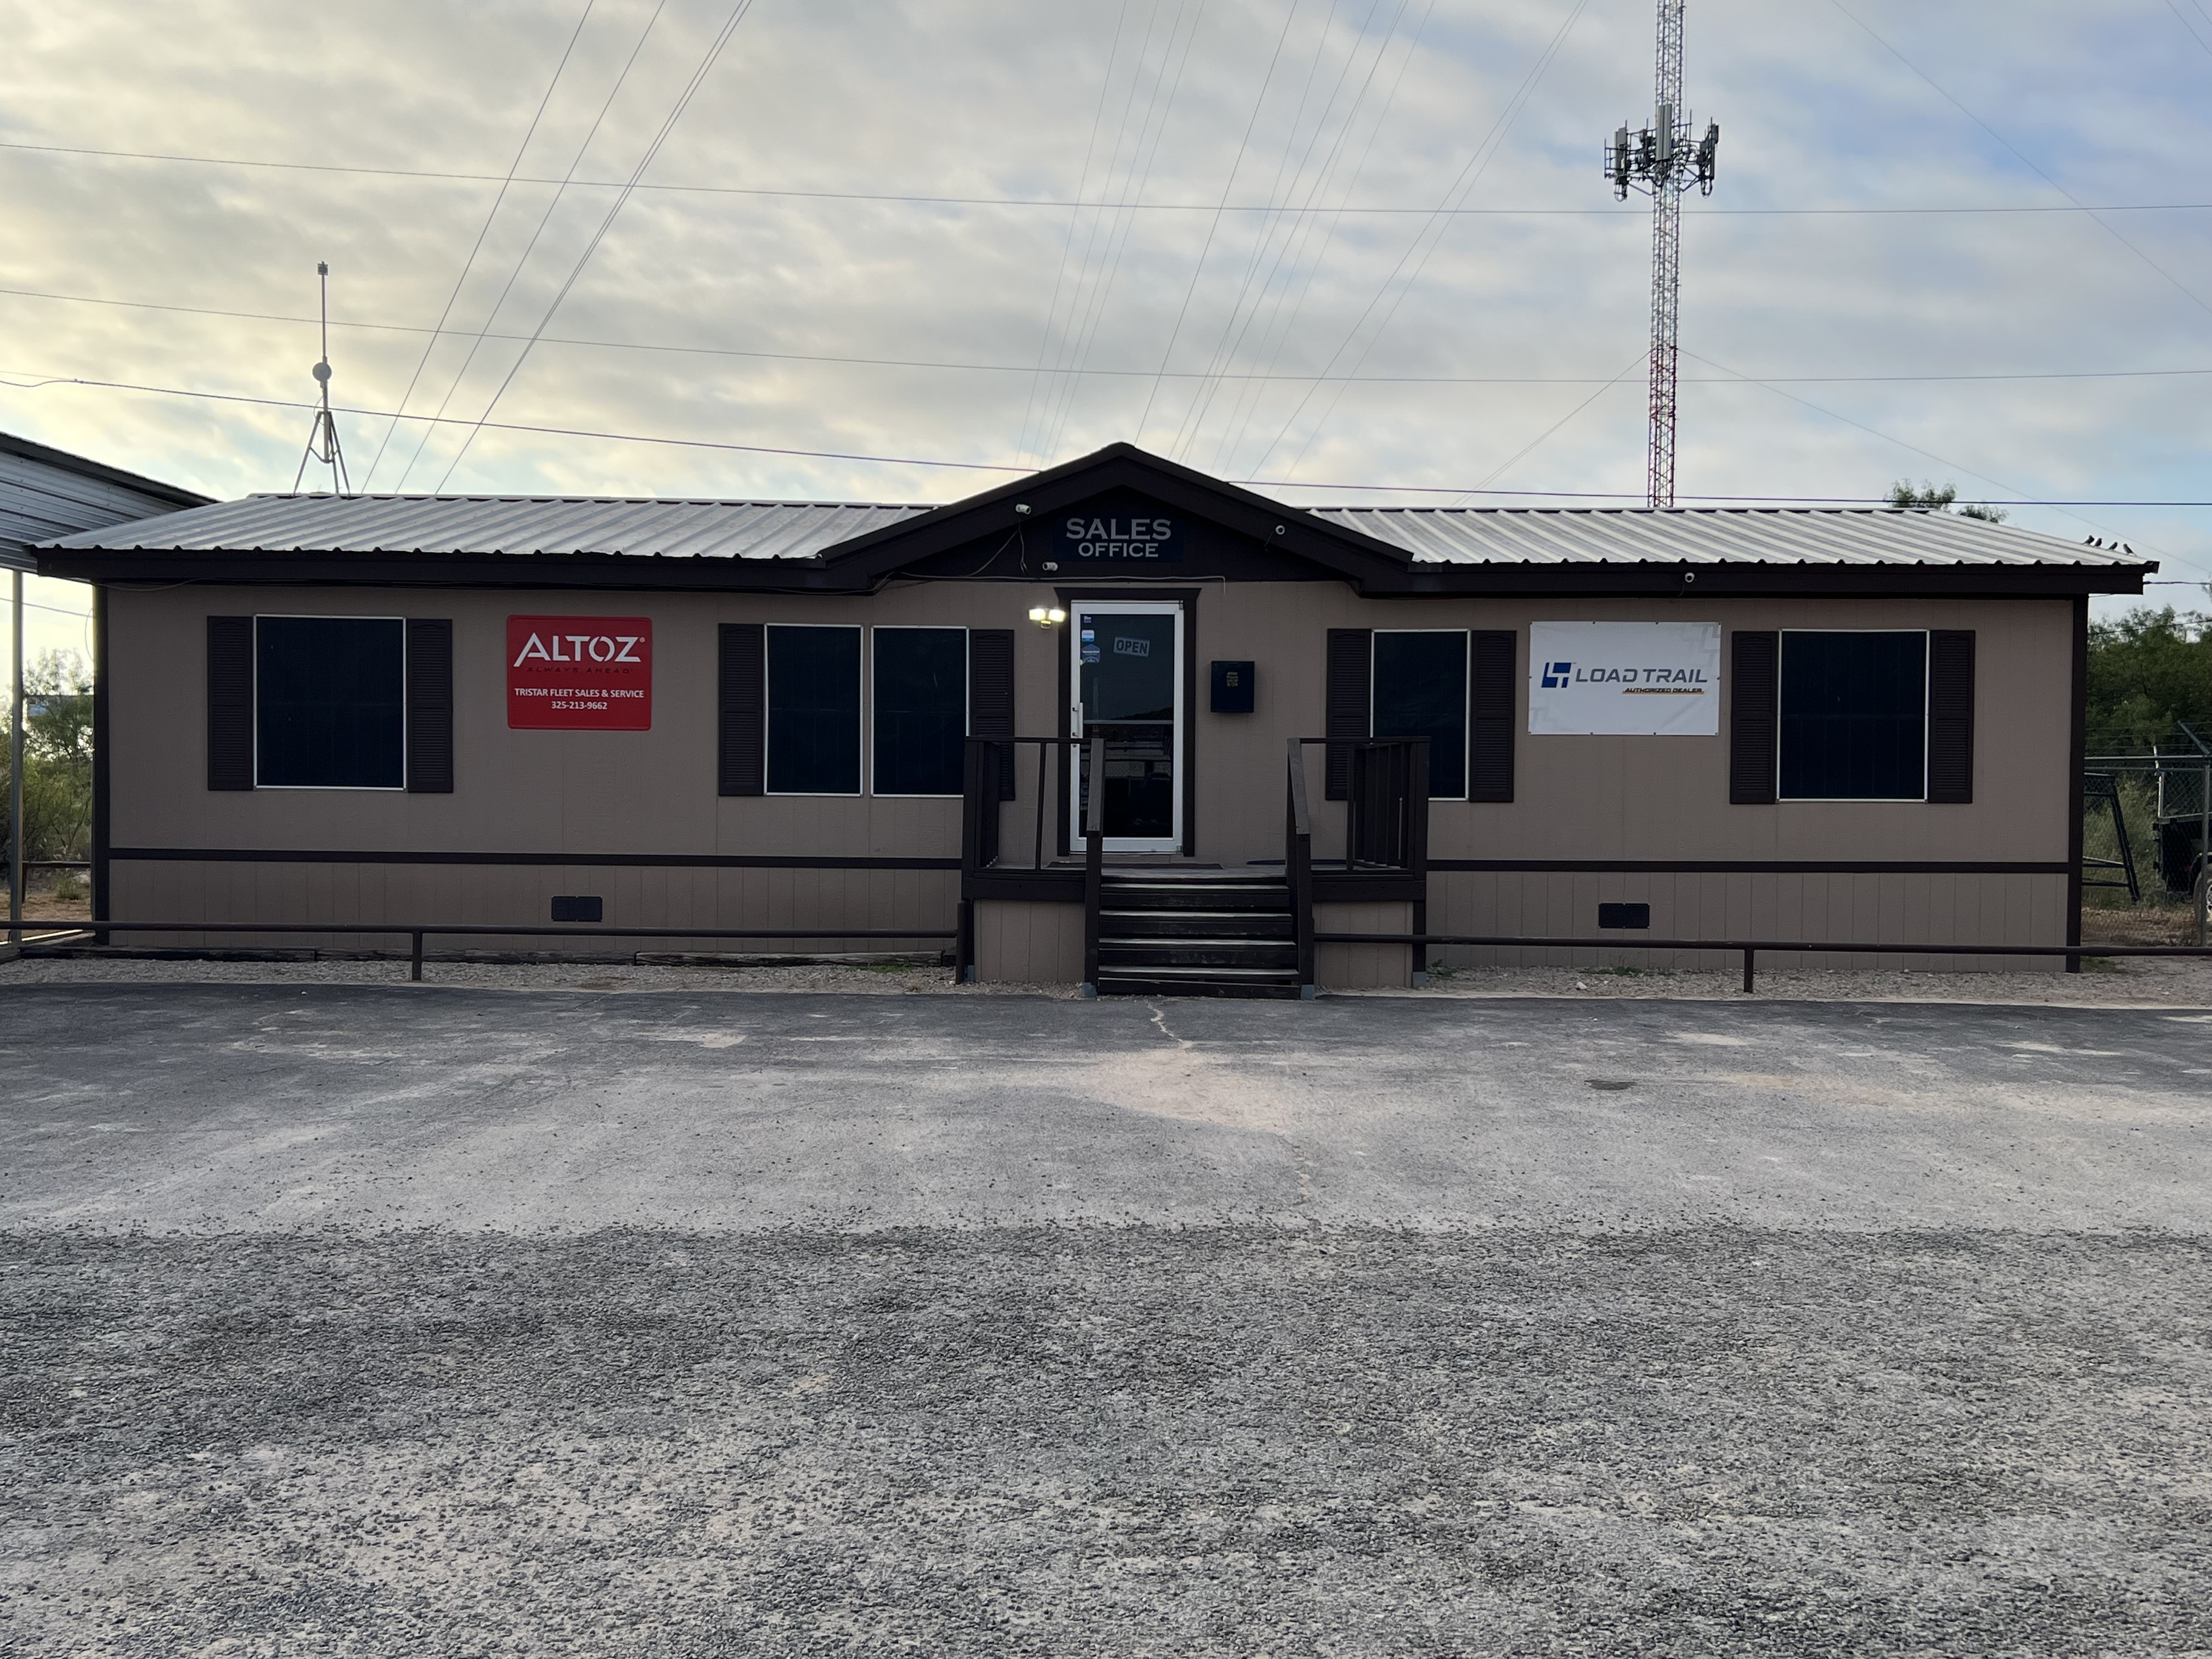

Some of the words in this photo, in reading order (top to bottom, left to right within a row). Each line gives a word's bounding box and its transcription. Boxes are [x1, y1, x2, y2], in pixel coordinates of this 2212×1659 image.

[1066, 518, 1171, 540] SALES
[1078, 542, 1159, 557] OFFICE
[514, 632, 641, 667] ALTOZ
[1116, 639, 1148, 654] OPEN
[1575, 668, 1638, 682] LOAD
[1643, 669, 1708, 683] TRAIL
[514, 688, 548, 696] TRISTAR
[550, 689, 573, 697] FLEET
[575, 689, 600, 697] SALES
[610, 690, 644, 698] SERVICE
[551, 701, 608, 709] 325-213-9662
